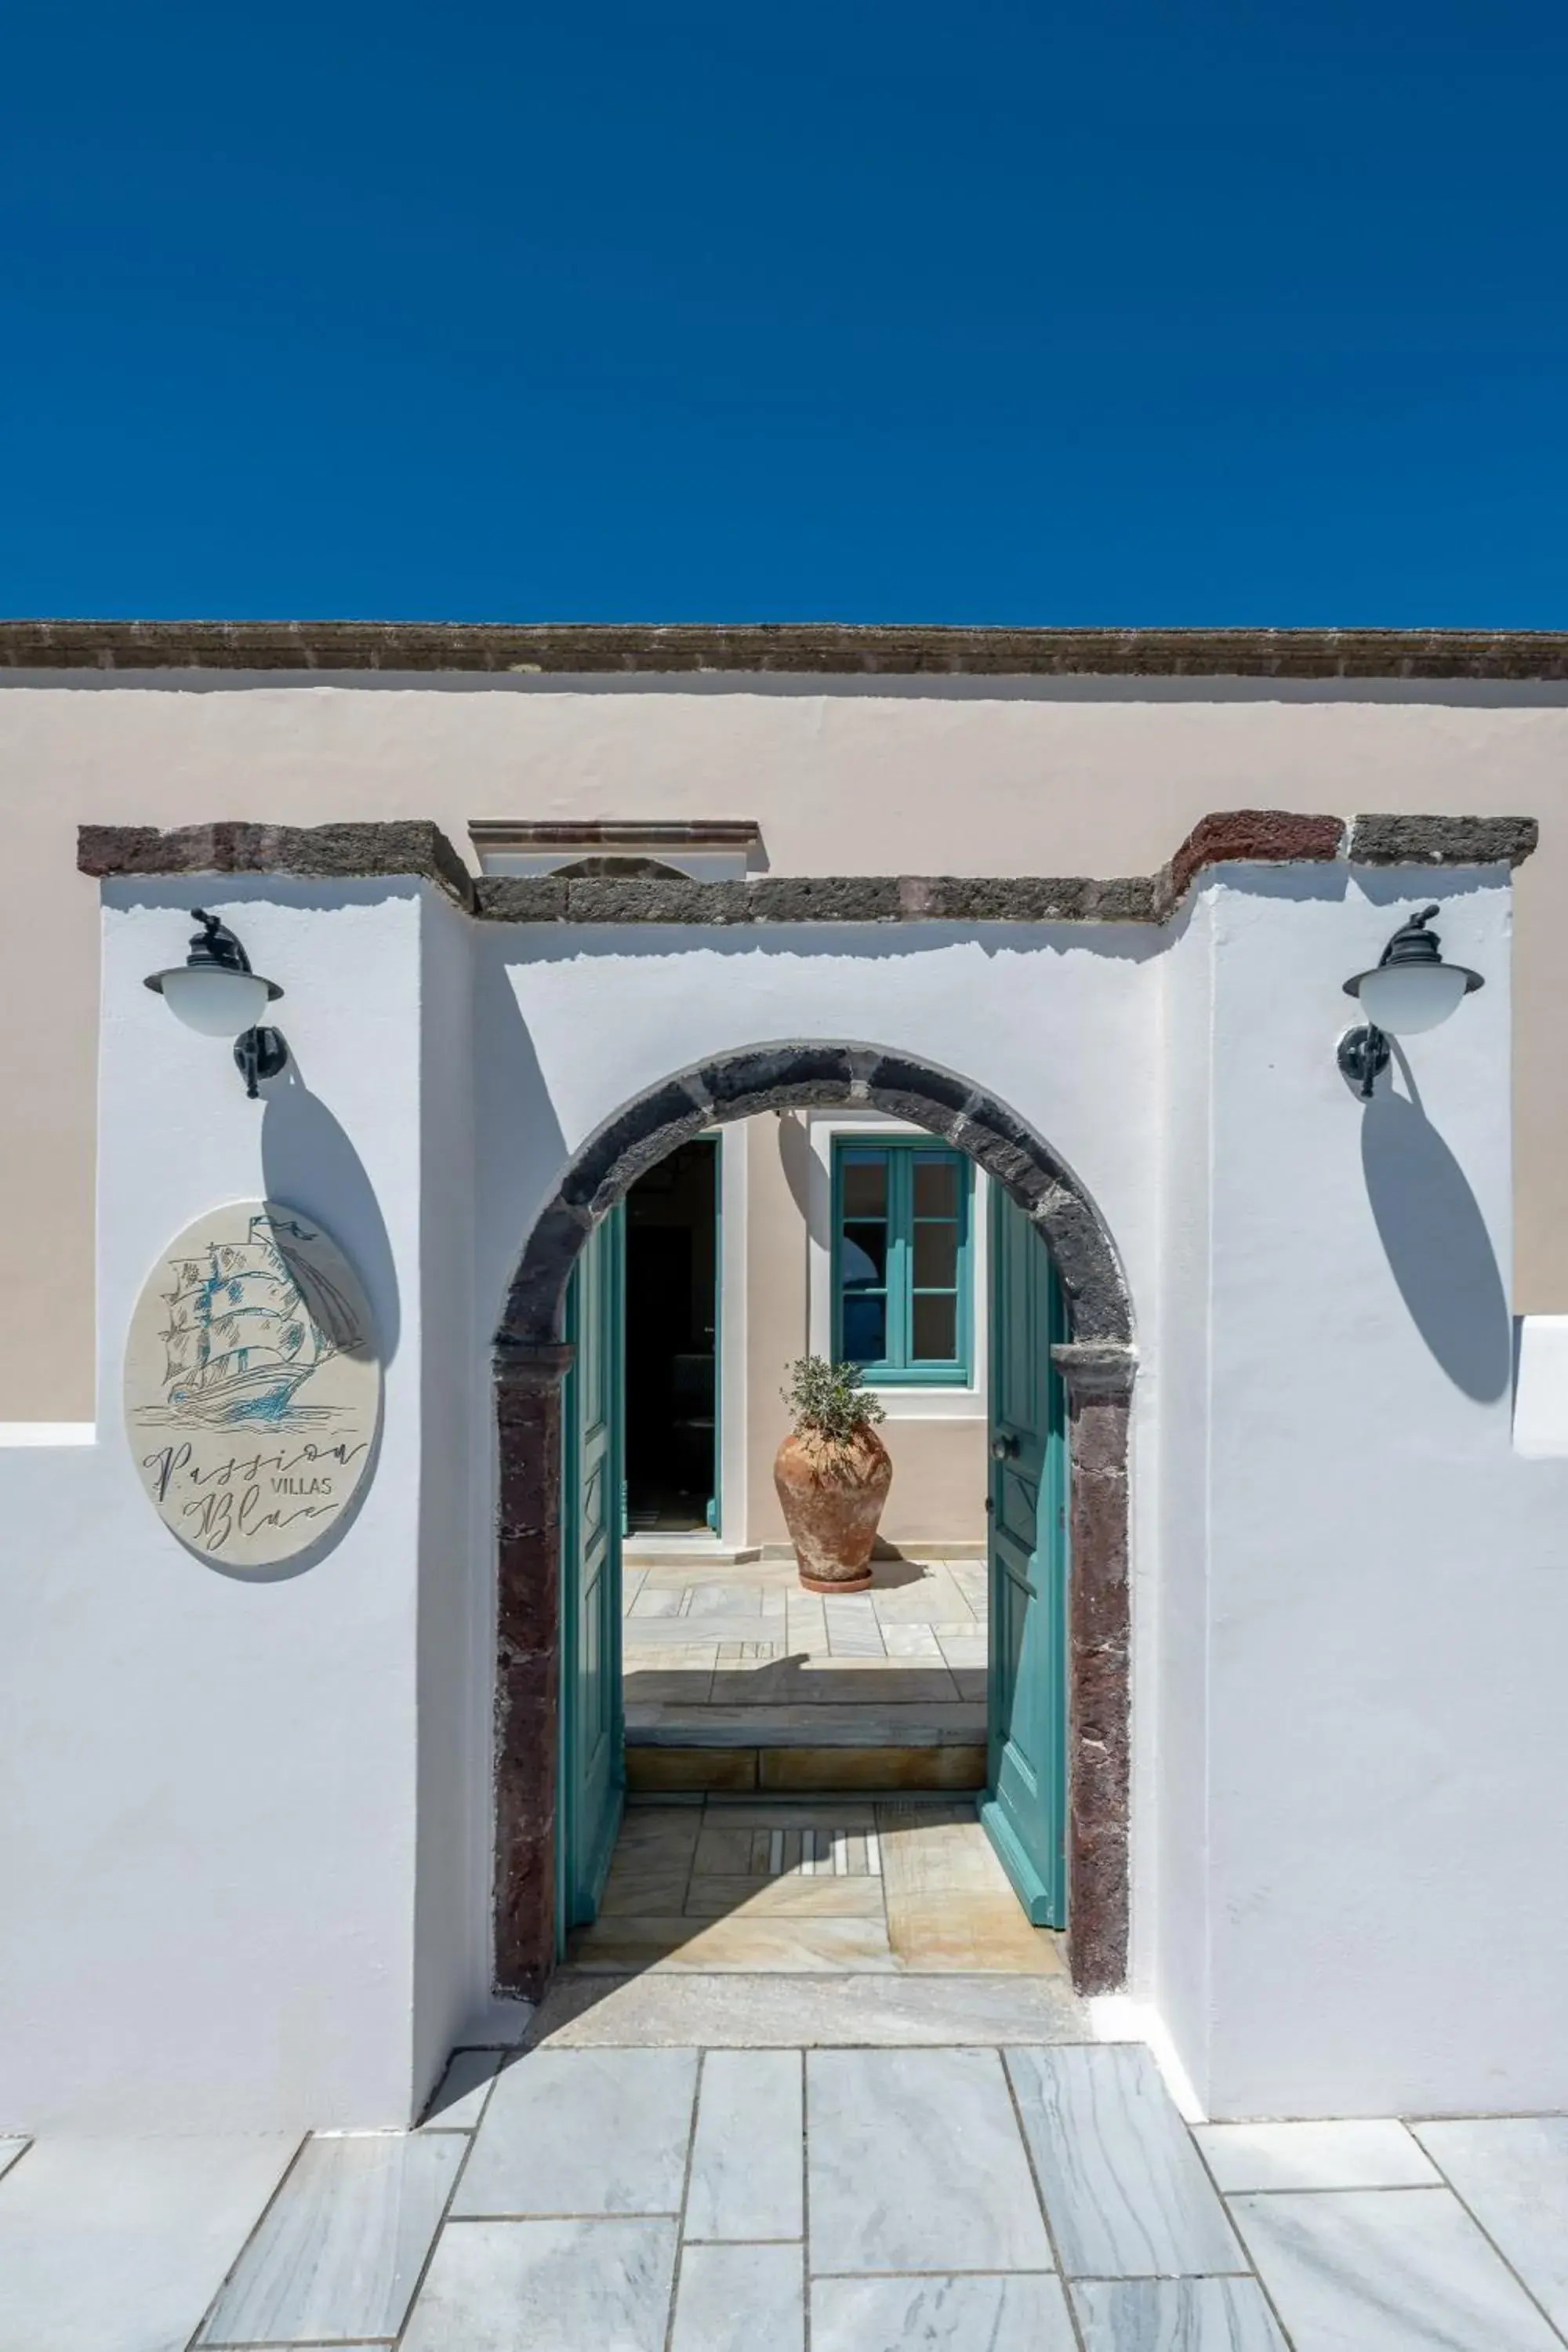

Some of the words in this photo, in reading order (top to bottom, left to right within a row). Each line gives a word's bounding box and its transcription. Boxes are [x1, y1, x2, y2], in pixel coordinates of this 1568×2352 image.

[143, 1442, 367, 1503] Passion
[270, 1478, 332, 1495] VILLAS
[183, 1484, 339, 1551] Blue
